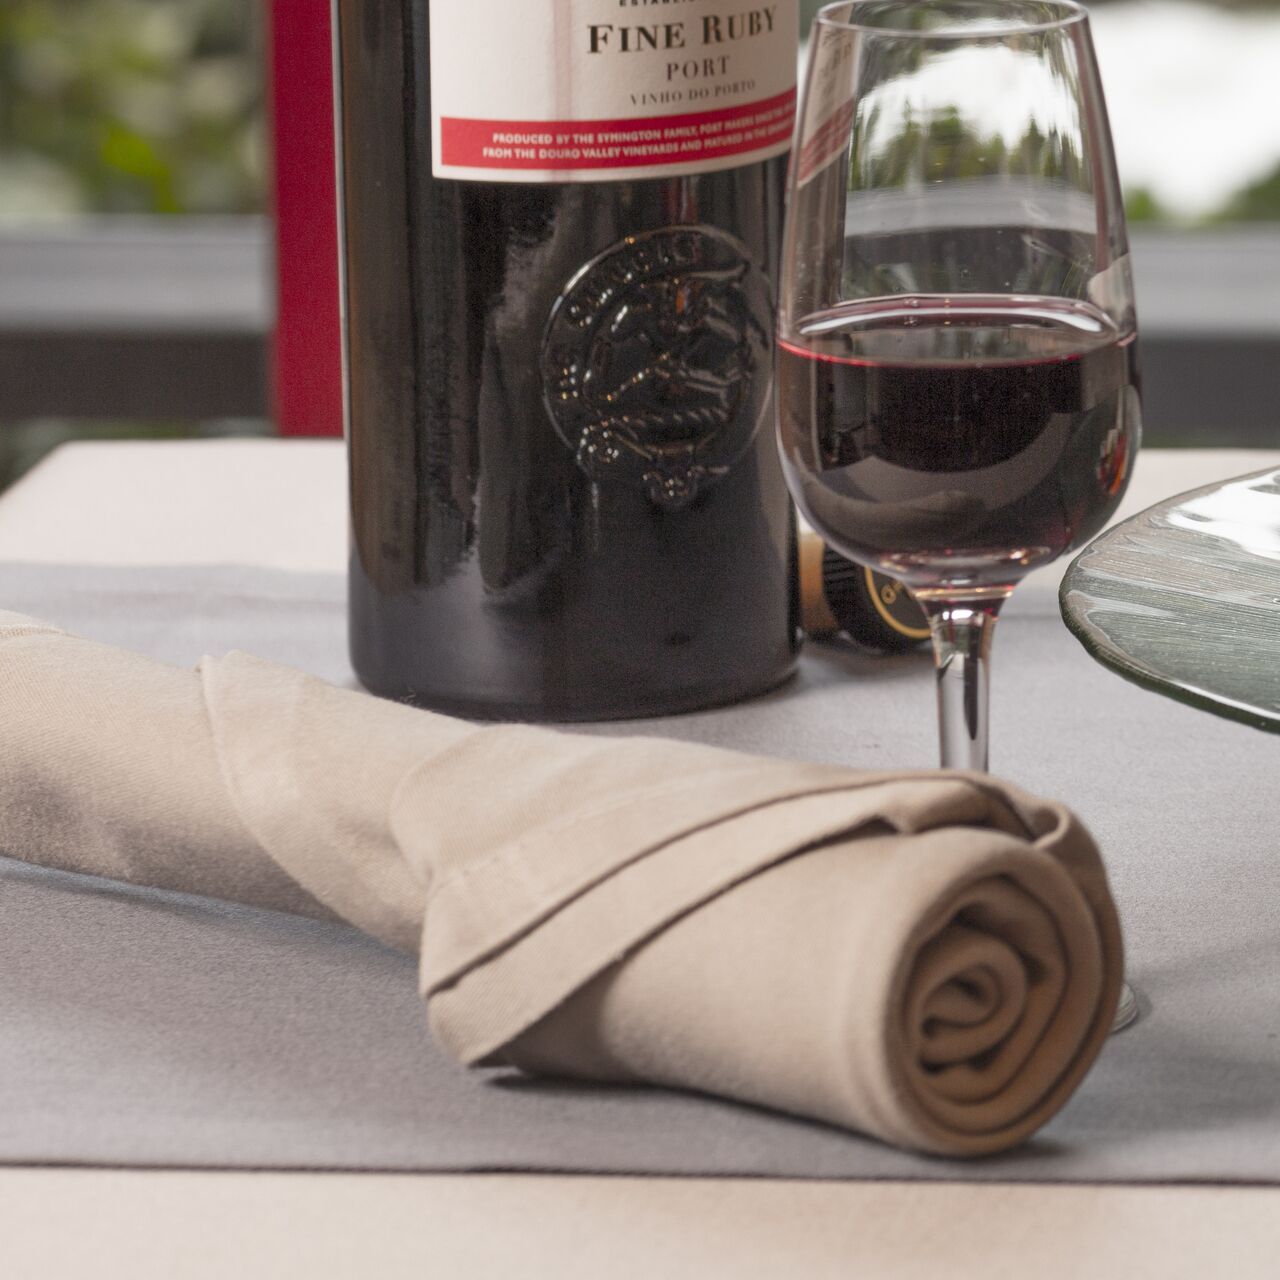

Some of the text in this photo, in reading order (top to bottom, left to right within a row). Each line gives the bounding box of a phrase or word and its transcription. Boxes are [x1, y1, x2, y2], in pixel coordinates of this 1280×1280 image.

[587, 4, 777, 55] FINE RUBY
[666, 55, 731, 82] PORT
[630, 80, 757, 106] VINHO DO PORTO
[482, 146, 513, 159] FROM
[515, 147, 536, 159] THE
[539, 147, 581, 160] DOURO
[582, 145, 621, 159] VALLEY
[621, 141, 680, 158] VINEYARDS
[680, 138, 703, 153] AND
[493, 132, 553, 144] PRODUCED
[556, 133, 570, 144] BY
[573, 132, 595, 144] THE
[597, 129, 662, 144] SYMINGTON
